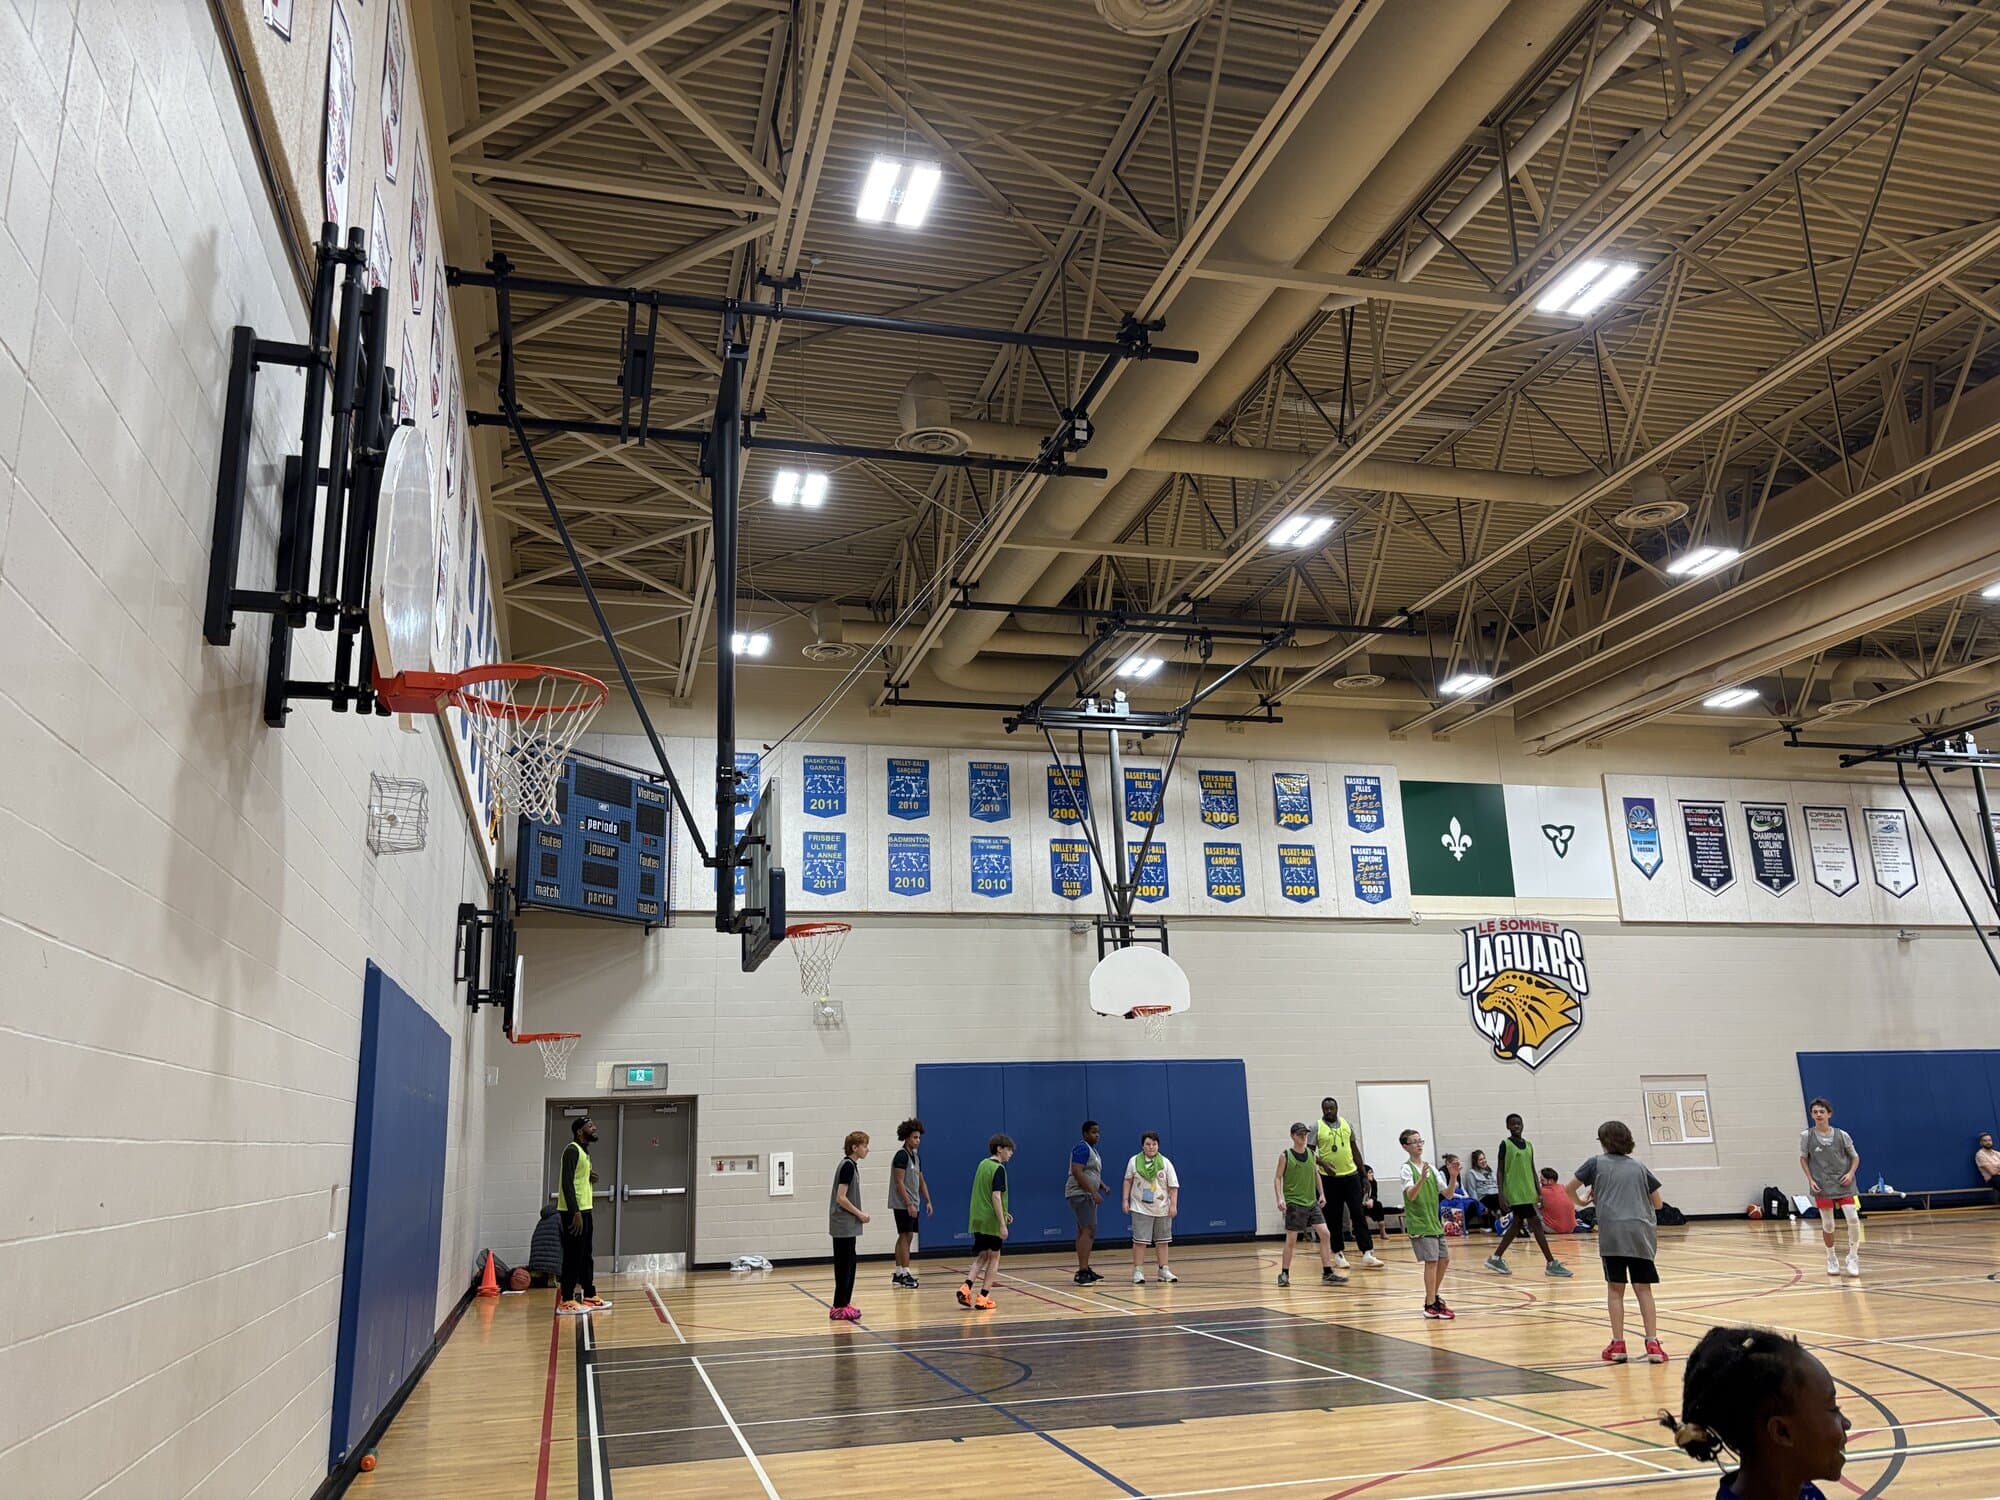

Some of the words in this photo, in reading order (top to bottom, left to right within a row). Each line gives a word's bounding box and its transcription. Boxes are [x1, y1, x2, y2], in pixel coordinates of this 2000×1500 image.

[1135, 780, 1152, 788] FILLES
[1346, 778, 1380, 786] BASKET-BALL
[810, 799, 839, 810] 2011
[898, 801, 918, 810] 2010
[980, 804, 1000, 812] 2010
[1130, 810, 1156, 822] 200
[1204, 812, 1237, 823] 2006
[1280, 814, 1309, 824] 2004
[1356, 814, 1377, 823] 2003
[538, 832, 562, 849] fautes
[1753, 832, 1784, 840] CHAMPIONS
[588, 842, 616, 856] joueur
[1051, 844, 1088, 852] VOLLEY-BALL
[1758, 841, 1782, 849] CURLING
[1206, 848, 1240, 856] BASKET-BALL
[1280, 848, 1314, 856] BASKET-BALL
[1352, 848, 1386, 856] BASKET-BALL
[640, 854, 660, 868] fautes
[1061, 853, 1080, 862] FILLES
[1211, 856, 1237, 866] GARÇONS
[1285, 856, 1311, 866] GARÇONS
[814, 880, 837, 888] 2011
[895, 878, 925, 888] 2010
[978, 878, 1006, 889] 2010
[536, 884, 559, 899] match
[1136, 886, 1164, 896] 2007
[1212, 885, 1242, 896] 2005
[1286, 885, 1316, 896] 2004
[1362, 886, 1384, 894] 2003
[588, 892, 614, 905] partie
[638, 902, 658, 915] match
[1478, 921, 1496, 934] LE
[1500, 919, 1559, 934] SOMMET
[1460, 927, 1588, 995] JAGUARS
